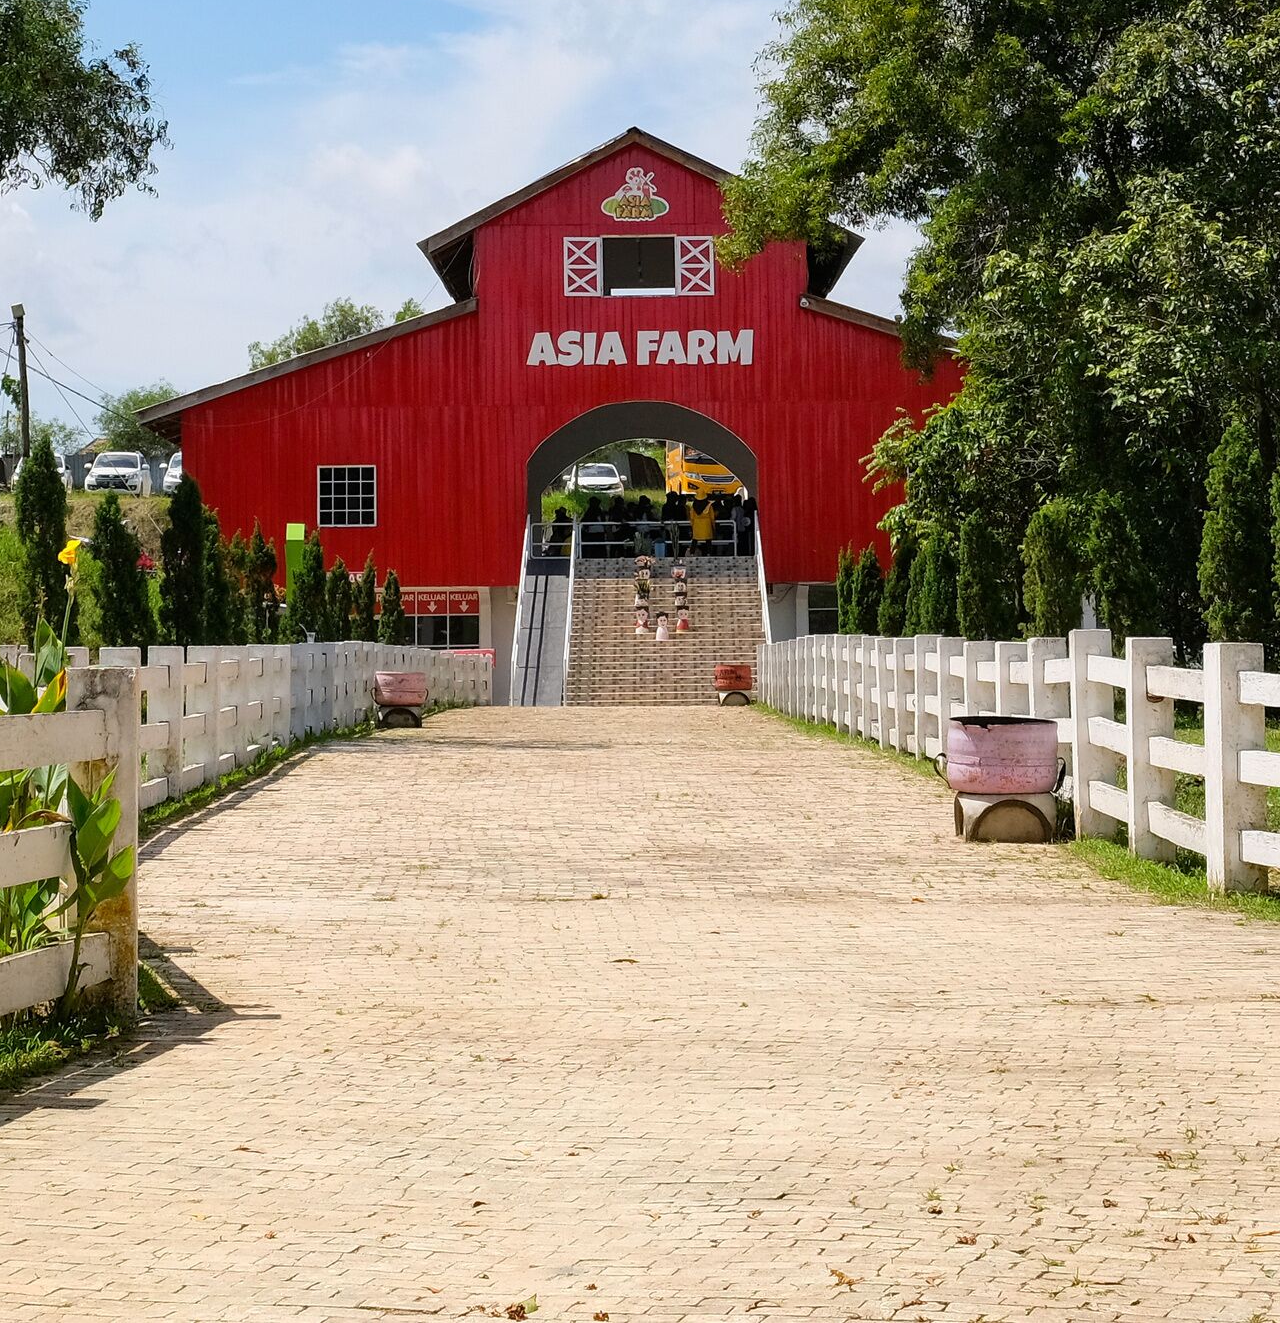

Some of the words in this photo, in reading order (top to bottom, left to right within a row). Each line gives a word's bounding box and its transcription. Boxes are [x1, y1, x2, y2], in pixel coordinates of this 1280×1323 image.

[619, 195, 651, 207] ASIA
[616, 206, 654, 218] FARM
[526, 330, 628, 367] ASIA
[636, 329, 754, 366] FARM
[418, 593, 446, 601] KELUAR
[449, 593, 478, 601] KELUAR
